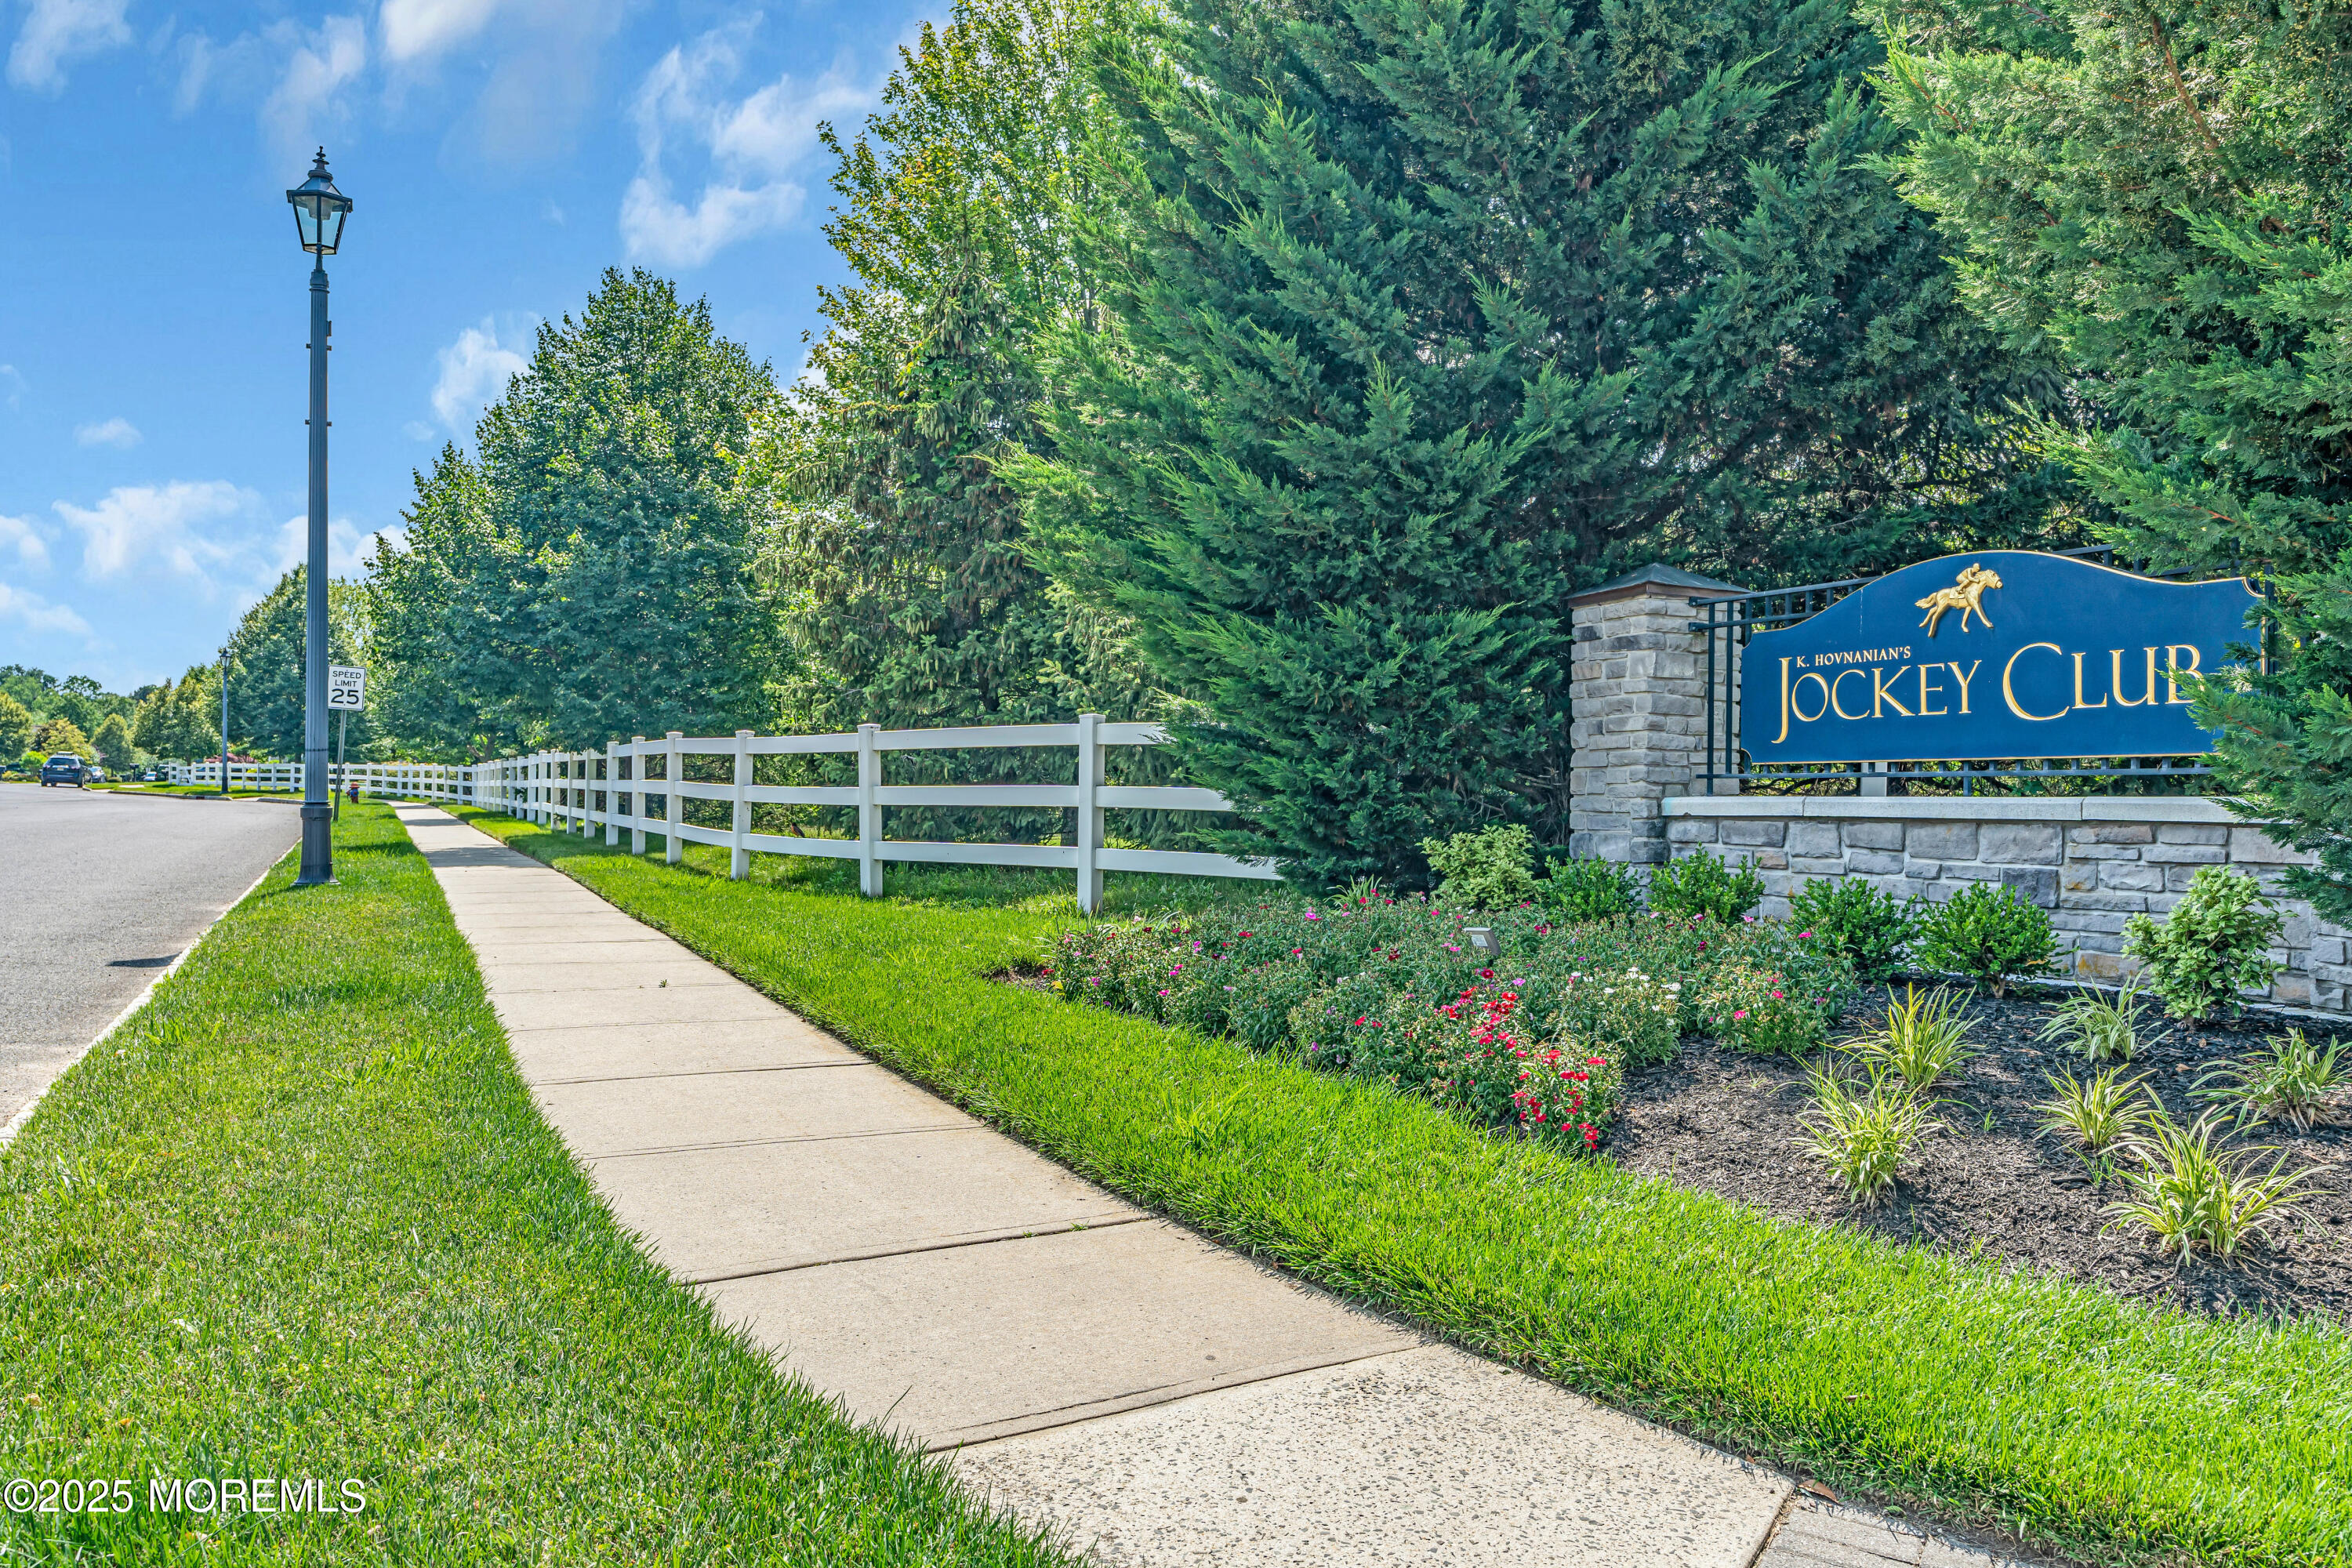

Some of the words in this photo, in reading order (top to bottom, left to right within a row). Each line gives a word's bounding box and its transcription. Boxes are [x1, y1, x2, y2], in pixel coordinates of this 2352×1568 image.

[1796, 655, 1810, 668] K.
[1815, 645, 1911, 666] HOVNANIAN'S
[332, 670, 361, 679] SPEED
[331, 688, 360, 705] 25
[1770, 657, 1983, 744] JOCKEY
[2003, 642, 2205, 720] CLUB
